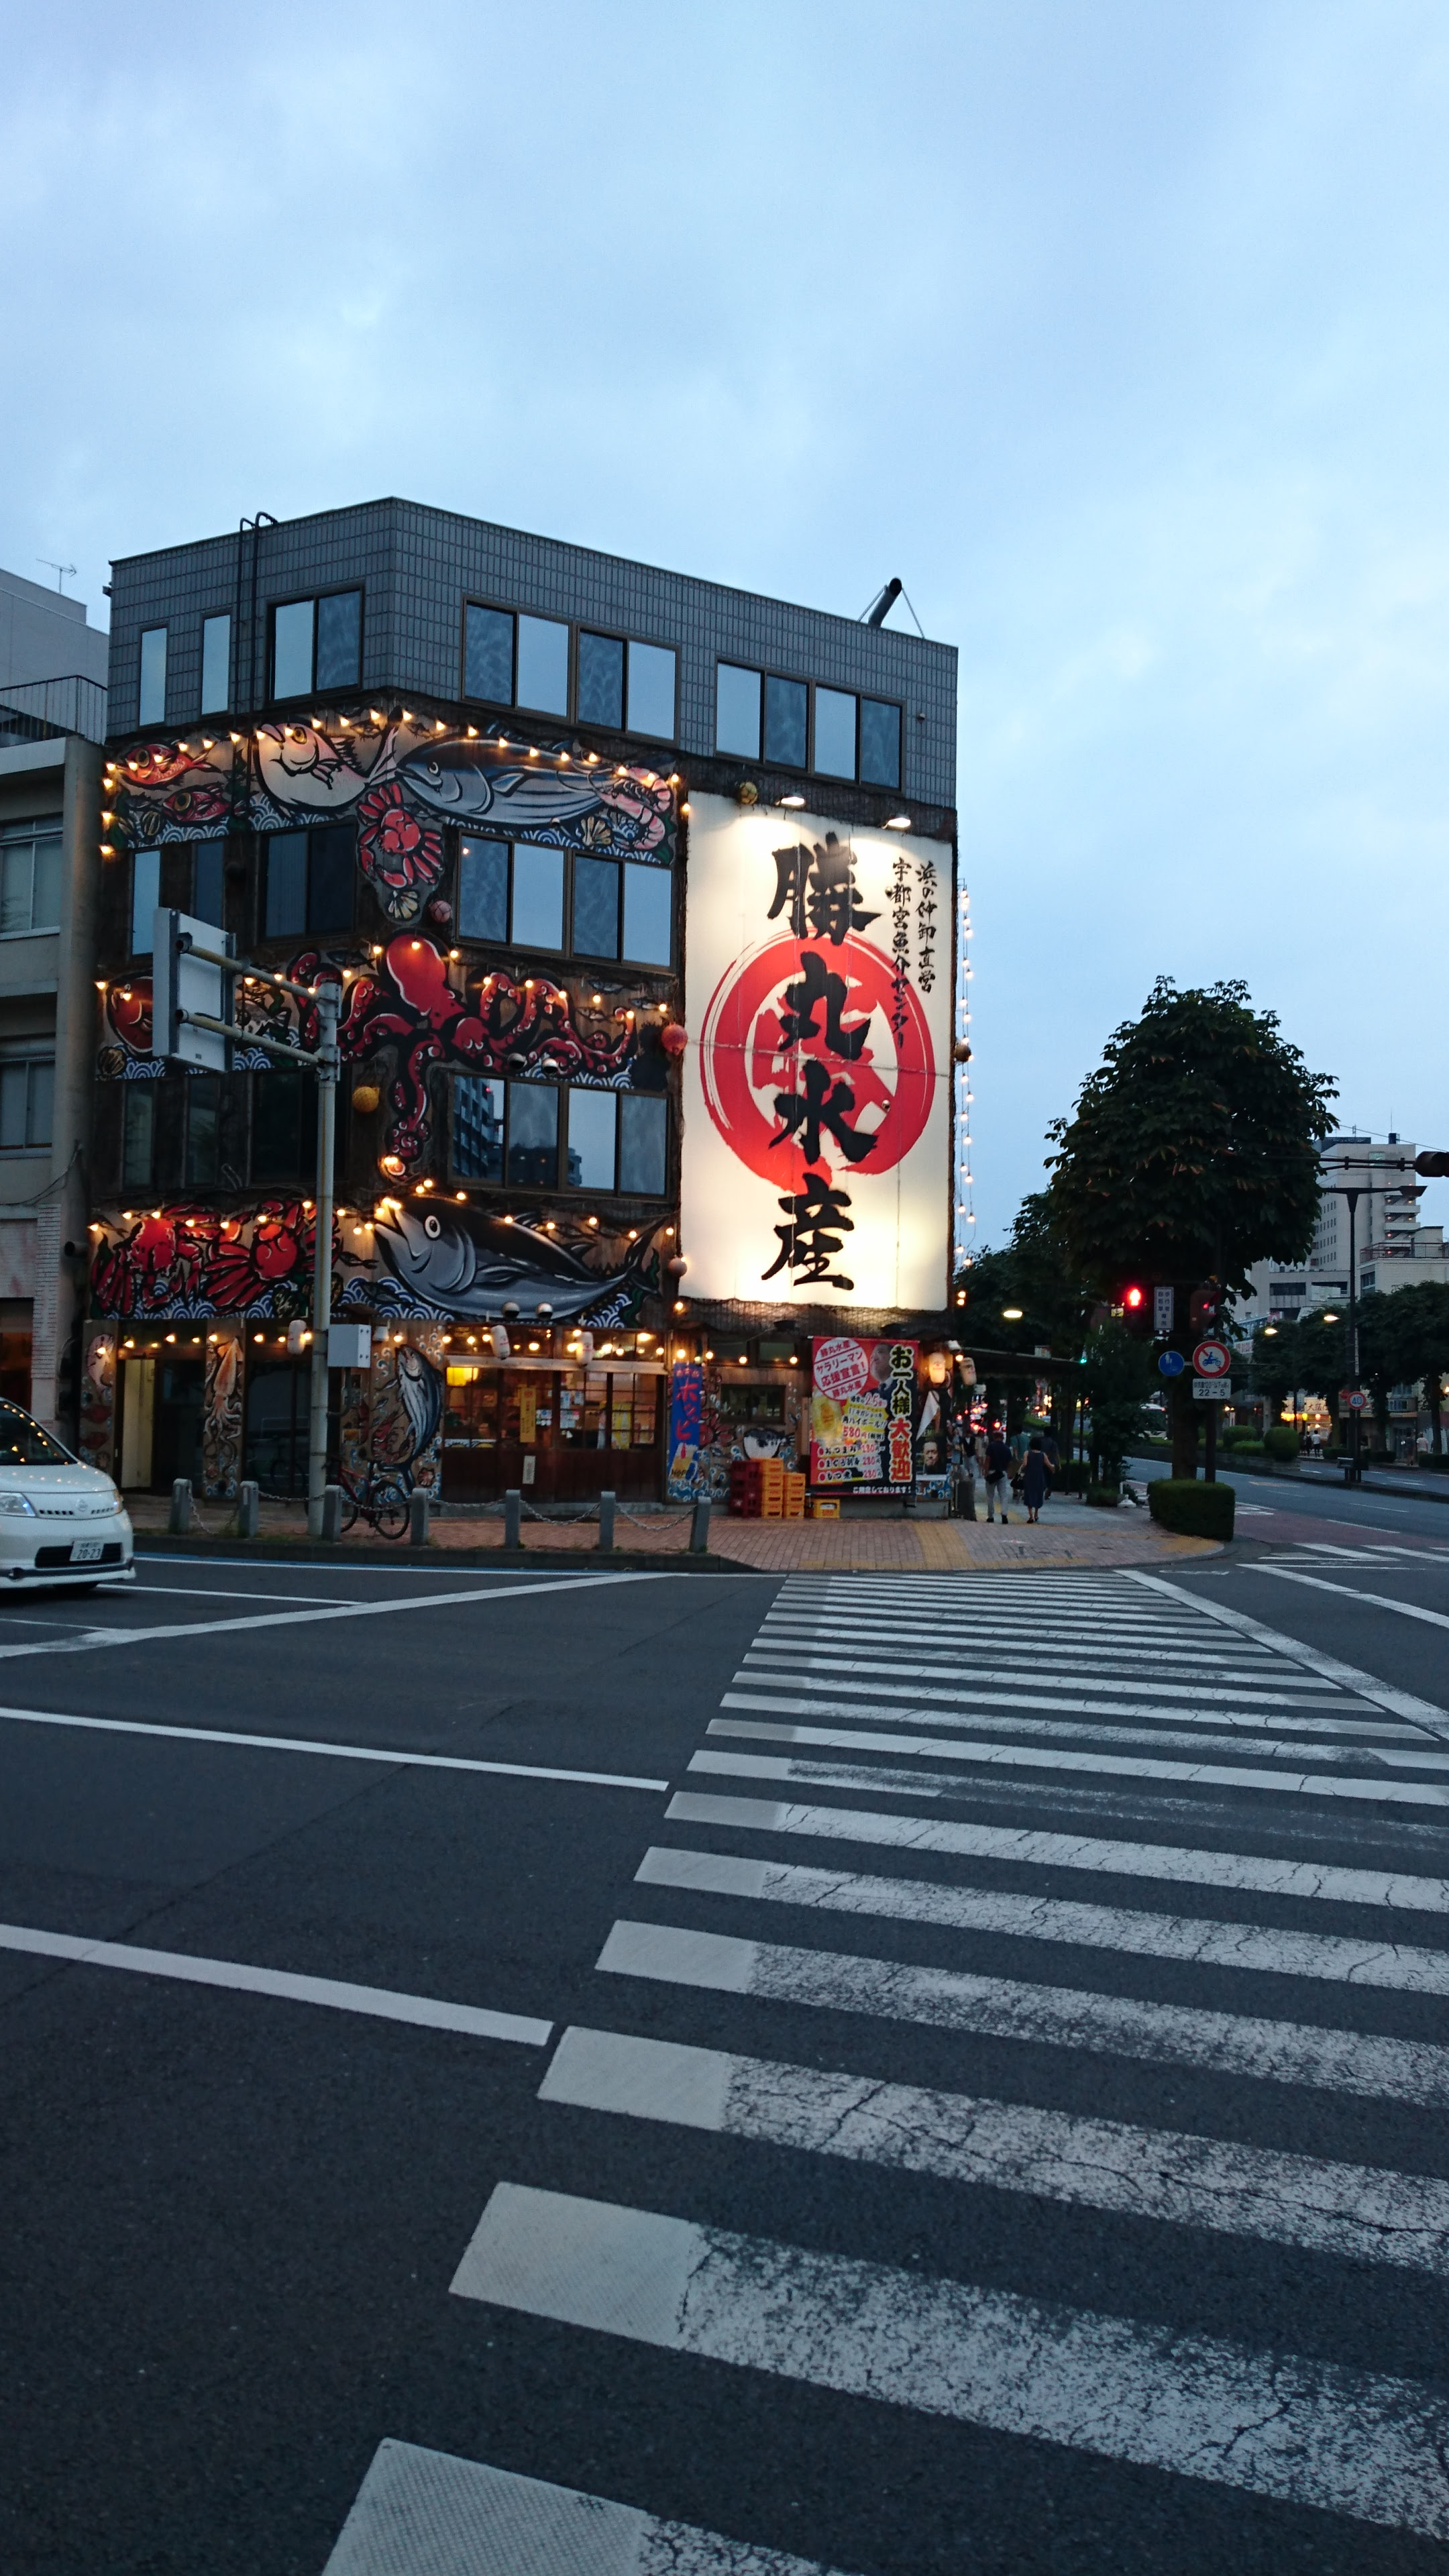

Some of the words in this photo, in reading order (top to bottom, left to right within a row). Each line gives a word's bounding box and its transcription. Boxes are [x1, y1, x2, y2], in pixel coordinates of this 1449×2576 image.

[890, 857, 912, 1049] 宇都宮魚介センター
[915, 860, 937, 993] 浜の仲卸直営
[762, 831, 882, 1291] 勝丸水産
[816, 1352, 863, 1375] サラリーマン
[889, 1345, 912, 1481] お一人様大歓迎
